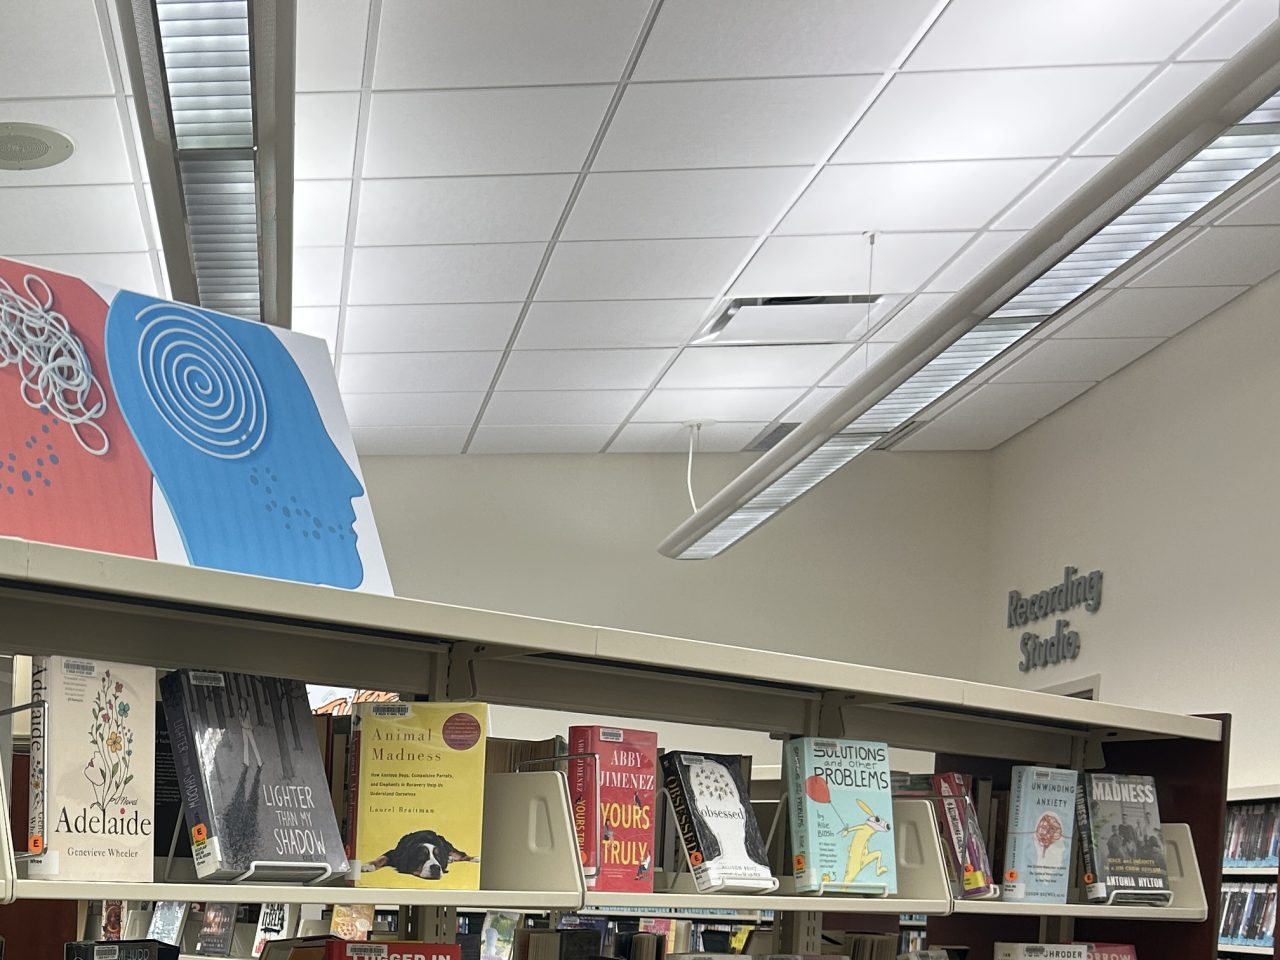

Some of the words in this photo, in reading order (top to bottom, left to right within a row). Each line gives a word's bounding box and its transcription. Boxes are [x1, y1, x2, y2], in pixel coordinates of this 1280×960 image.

[1007, 566, 1104, 629] Recording
[1019, 619, 1081, 673] Studio
[372, 728, 432, 742] Animal
[372, 747, 442, 762] Madness
[611, 750, 643, 768] ABBY
[599, 770, 655, 792] JIMENEZ
[1031, 782, 1075, 794] UNWINDING
[263, 784, 315, 810] LIGHTER
[1036, 797, 1067, 808] ANXIETY
[1092, 781, 1154, 804] MADNESS
[55, 805, 151, 836] Adelaide
[599, 802, 650, 830] YOURS
[700, 805, 744, 821] obsessed
[274, 827, 326, 855] SHADOW
[67, 847, 105, 858] Genevieve
[108, 848, 138, 858] Wheeler
[601, 840, 647, 866] TRULY
